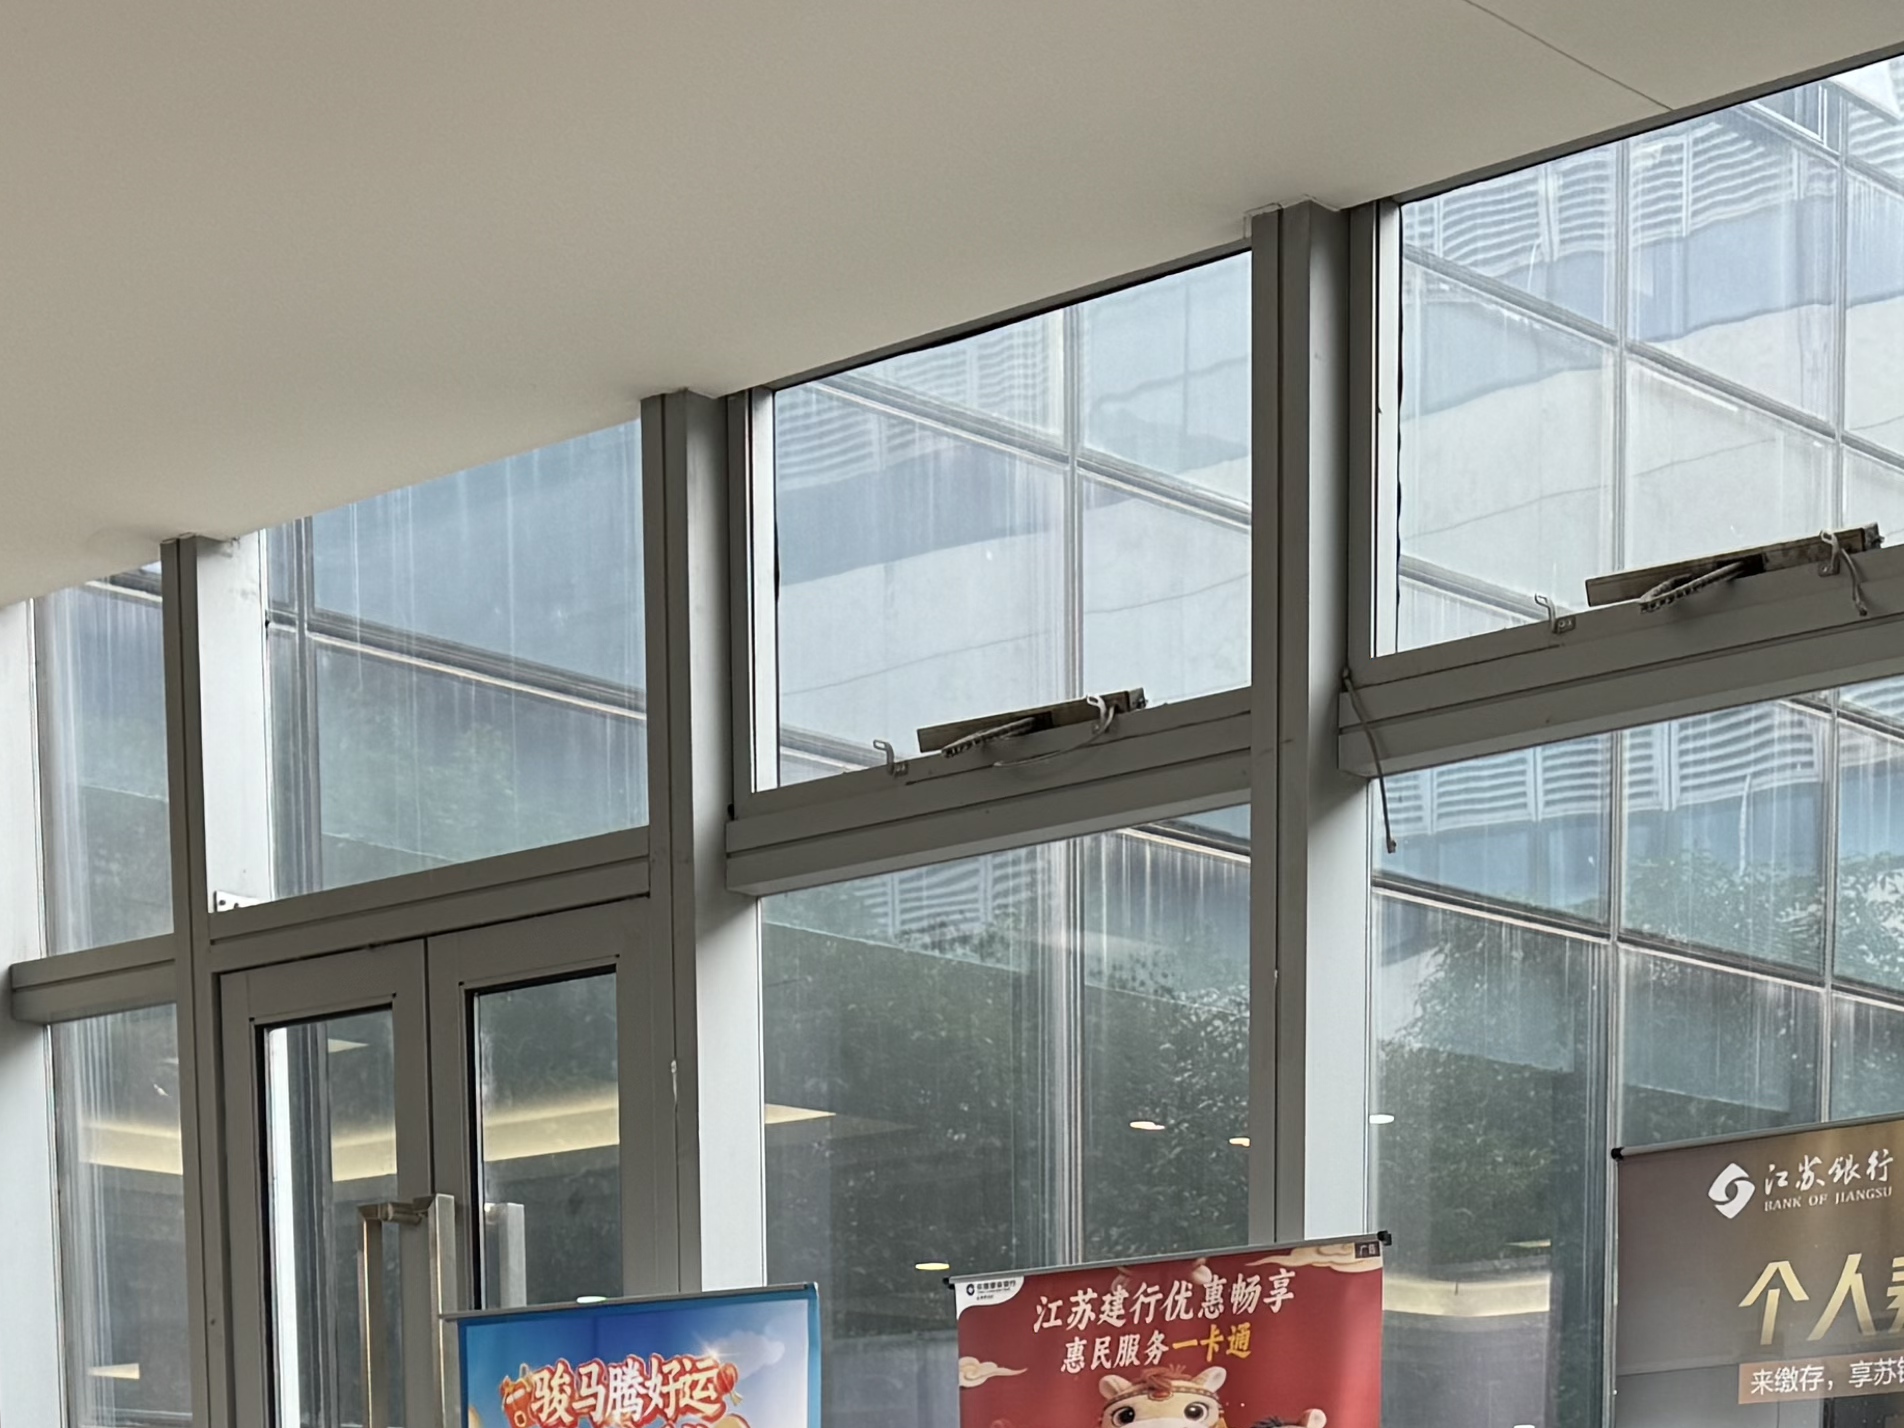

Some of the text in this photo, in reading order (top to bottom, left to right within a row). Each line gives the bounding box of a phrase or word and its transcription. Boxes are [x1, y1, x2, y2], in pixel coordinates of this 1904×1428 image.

[1764, 1148, 1894, 1196] 江苏银行
[1764, 1186, 1893, 1212] BANK OF JIANGSU
[1032, 1268, 1296, 1334] 江苏建行优惠畅享
[1060, 1321, 1253, 1374] 惠民服务一卡通
[530, 1354, 724, 1428] 骏马腾好运
